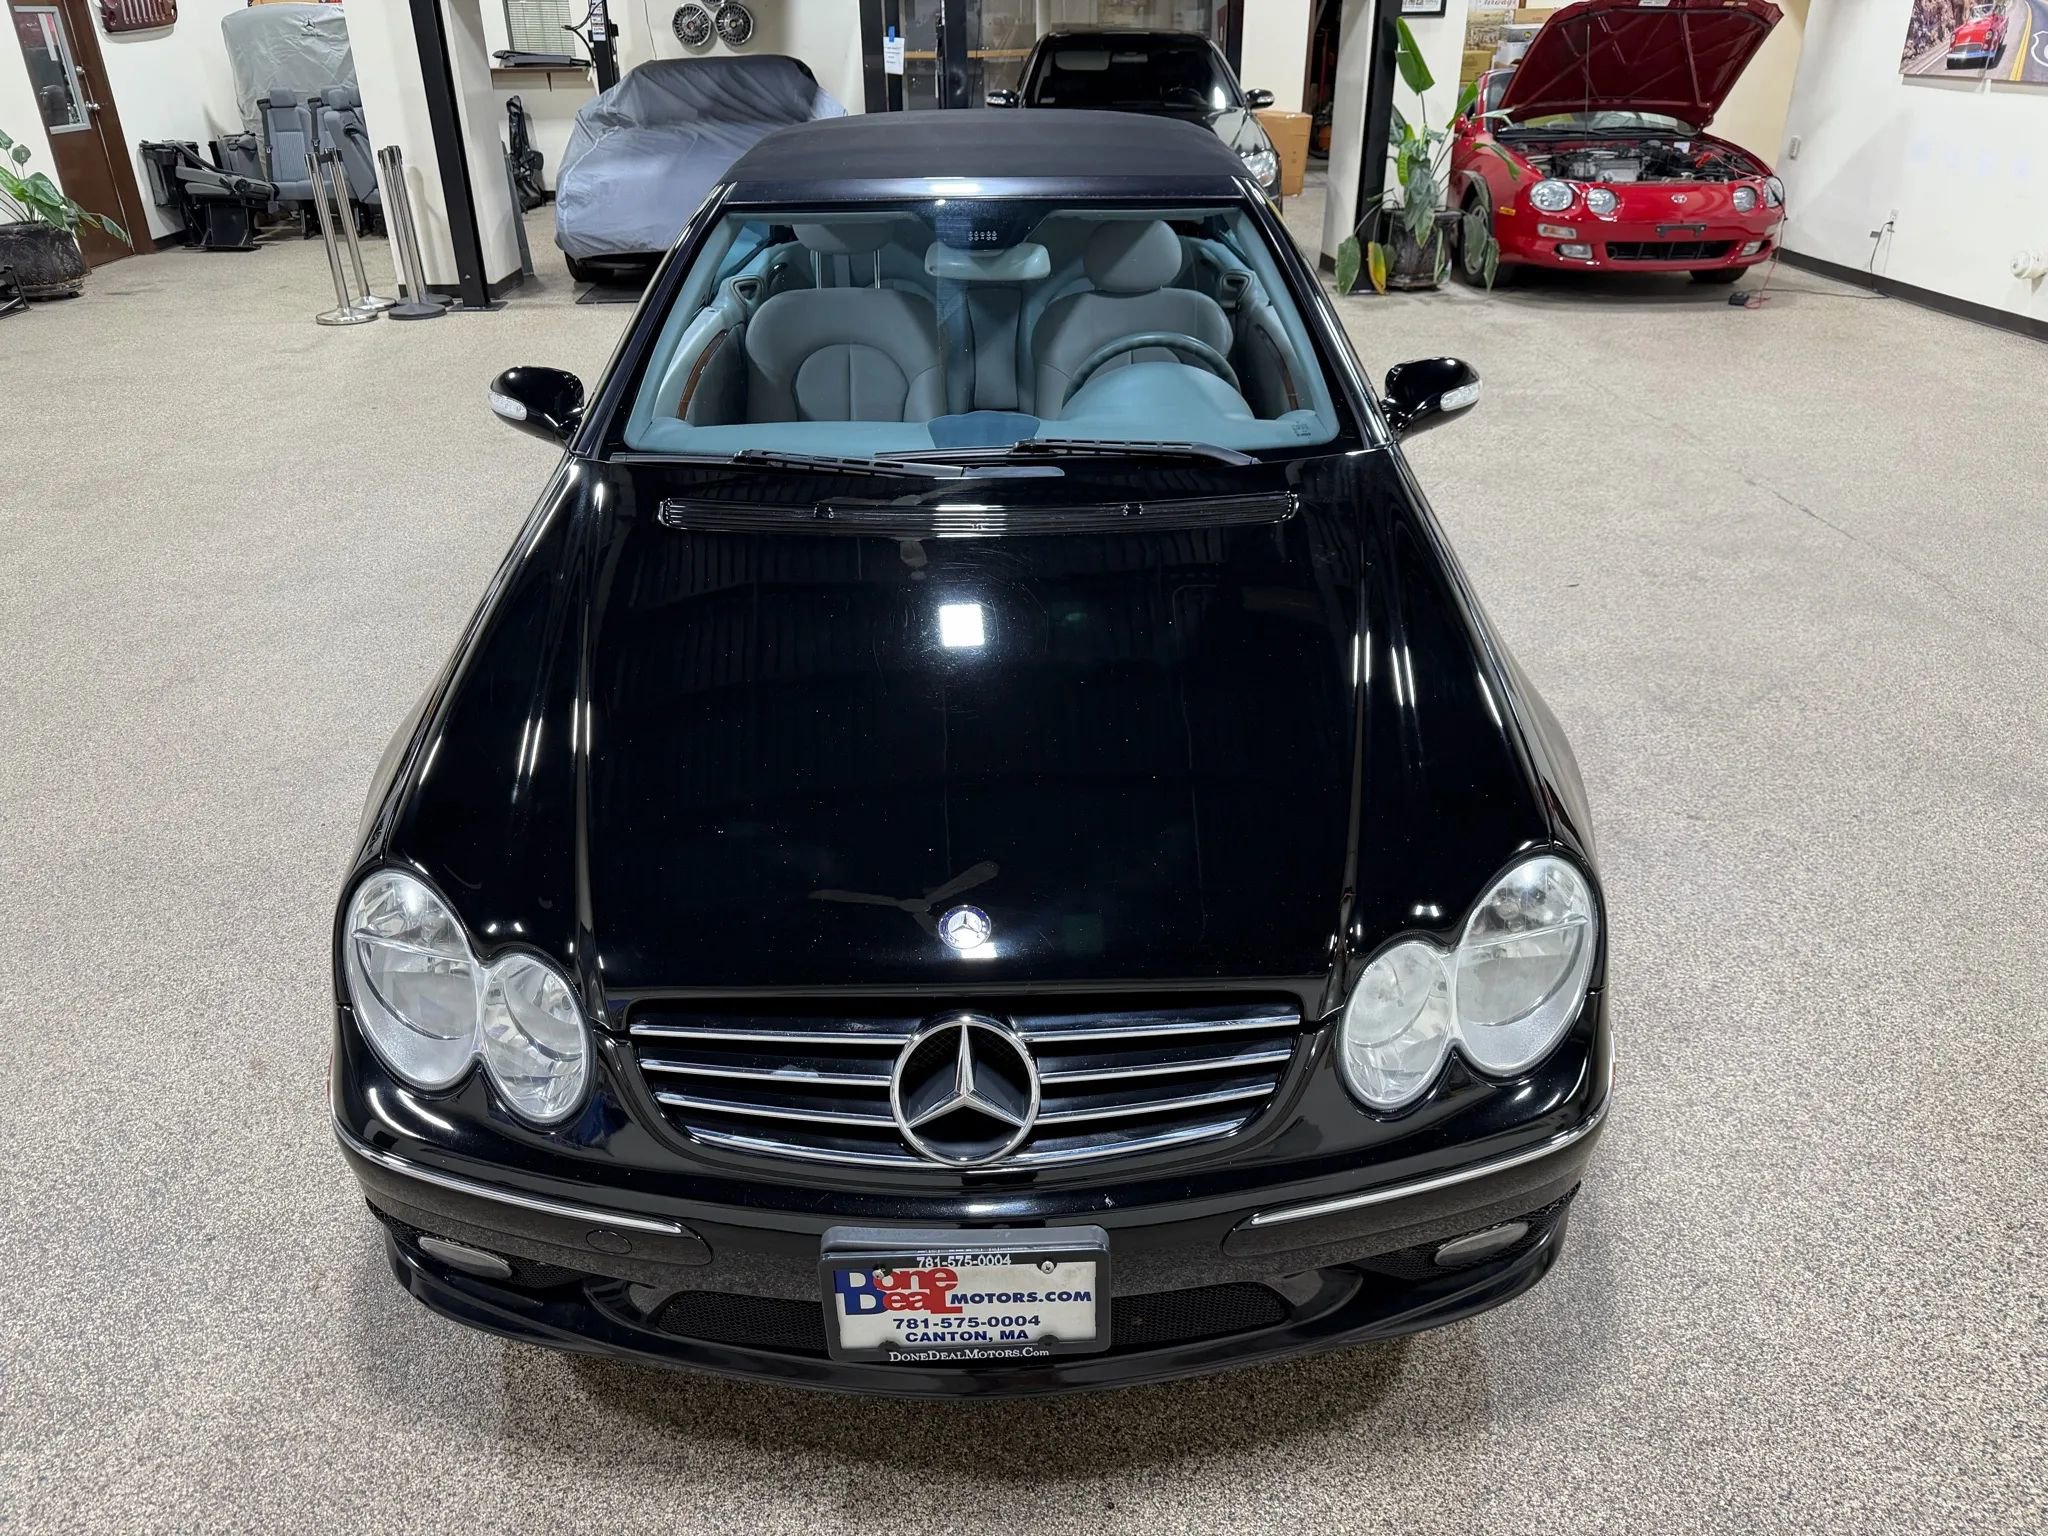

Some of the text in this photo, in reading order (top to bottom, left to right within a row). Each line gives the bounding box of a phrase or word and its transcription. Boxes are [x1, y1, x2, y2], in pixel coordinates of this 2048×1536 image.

[916, 1254, 1012, 1268] 781-575-0004
[833, 1267, 959, 1294] Done
[950, 1290, 1092, 1305] MOTORS.COM
[892, 1315, 1041, 1330] 781-575-0004
[905, 1329, 1029, 1343] CANTON, MA
